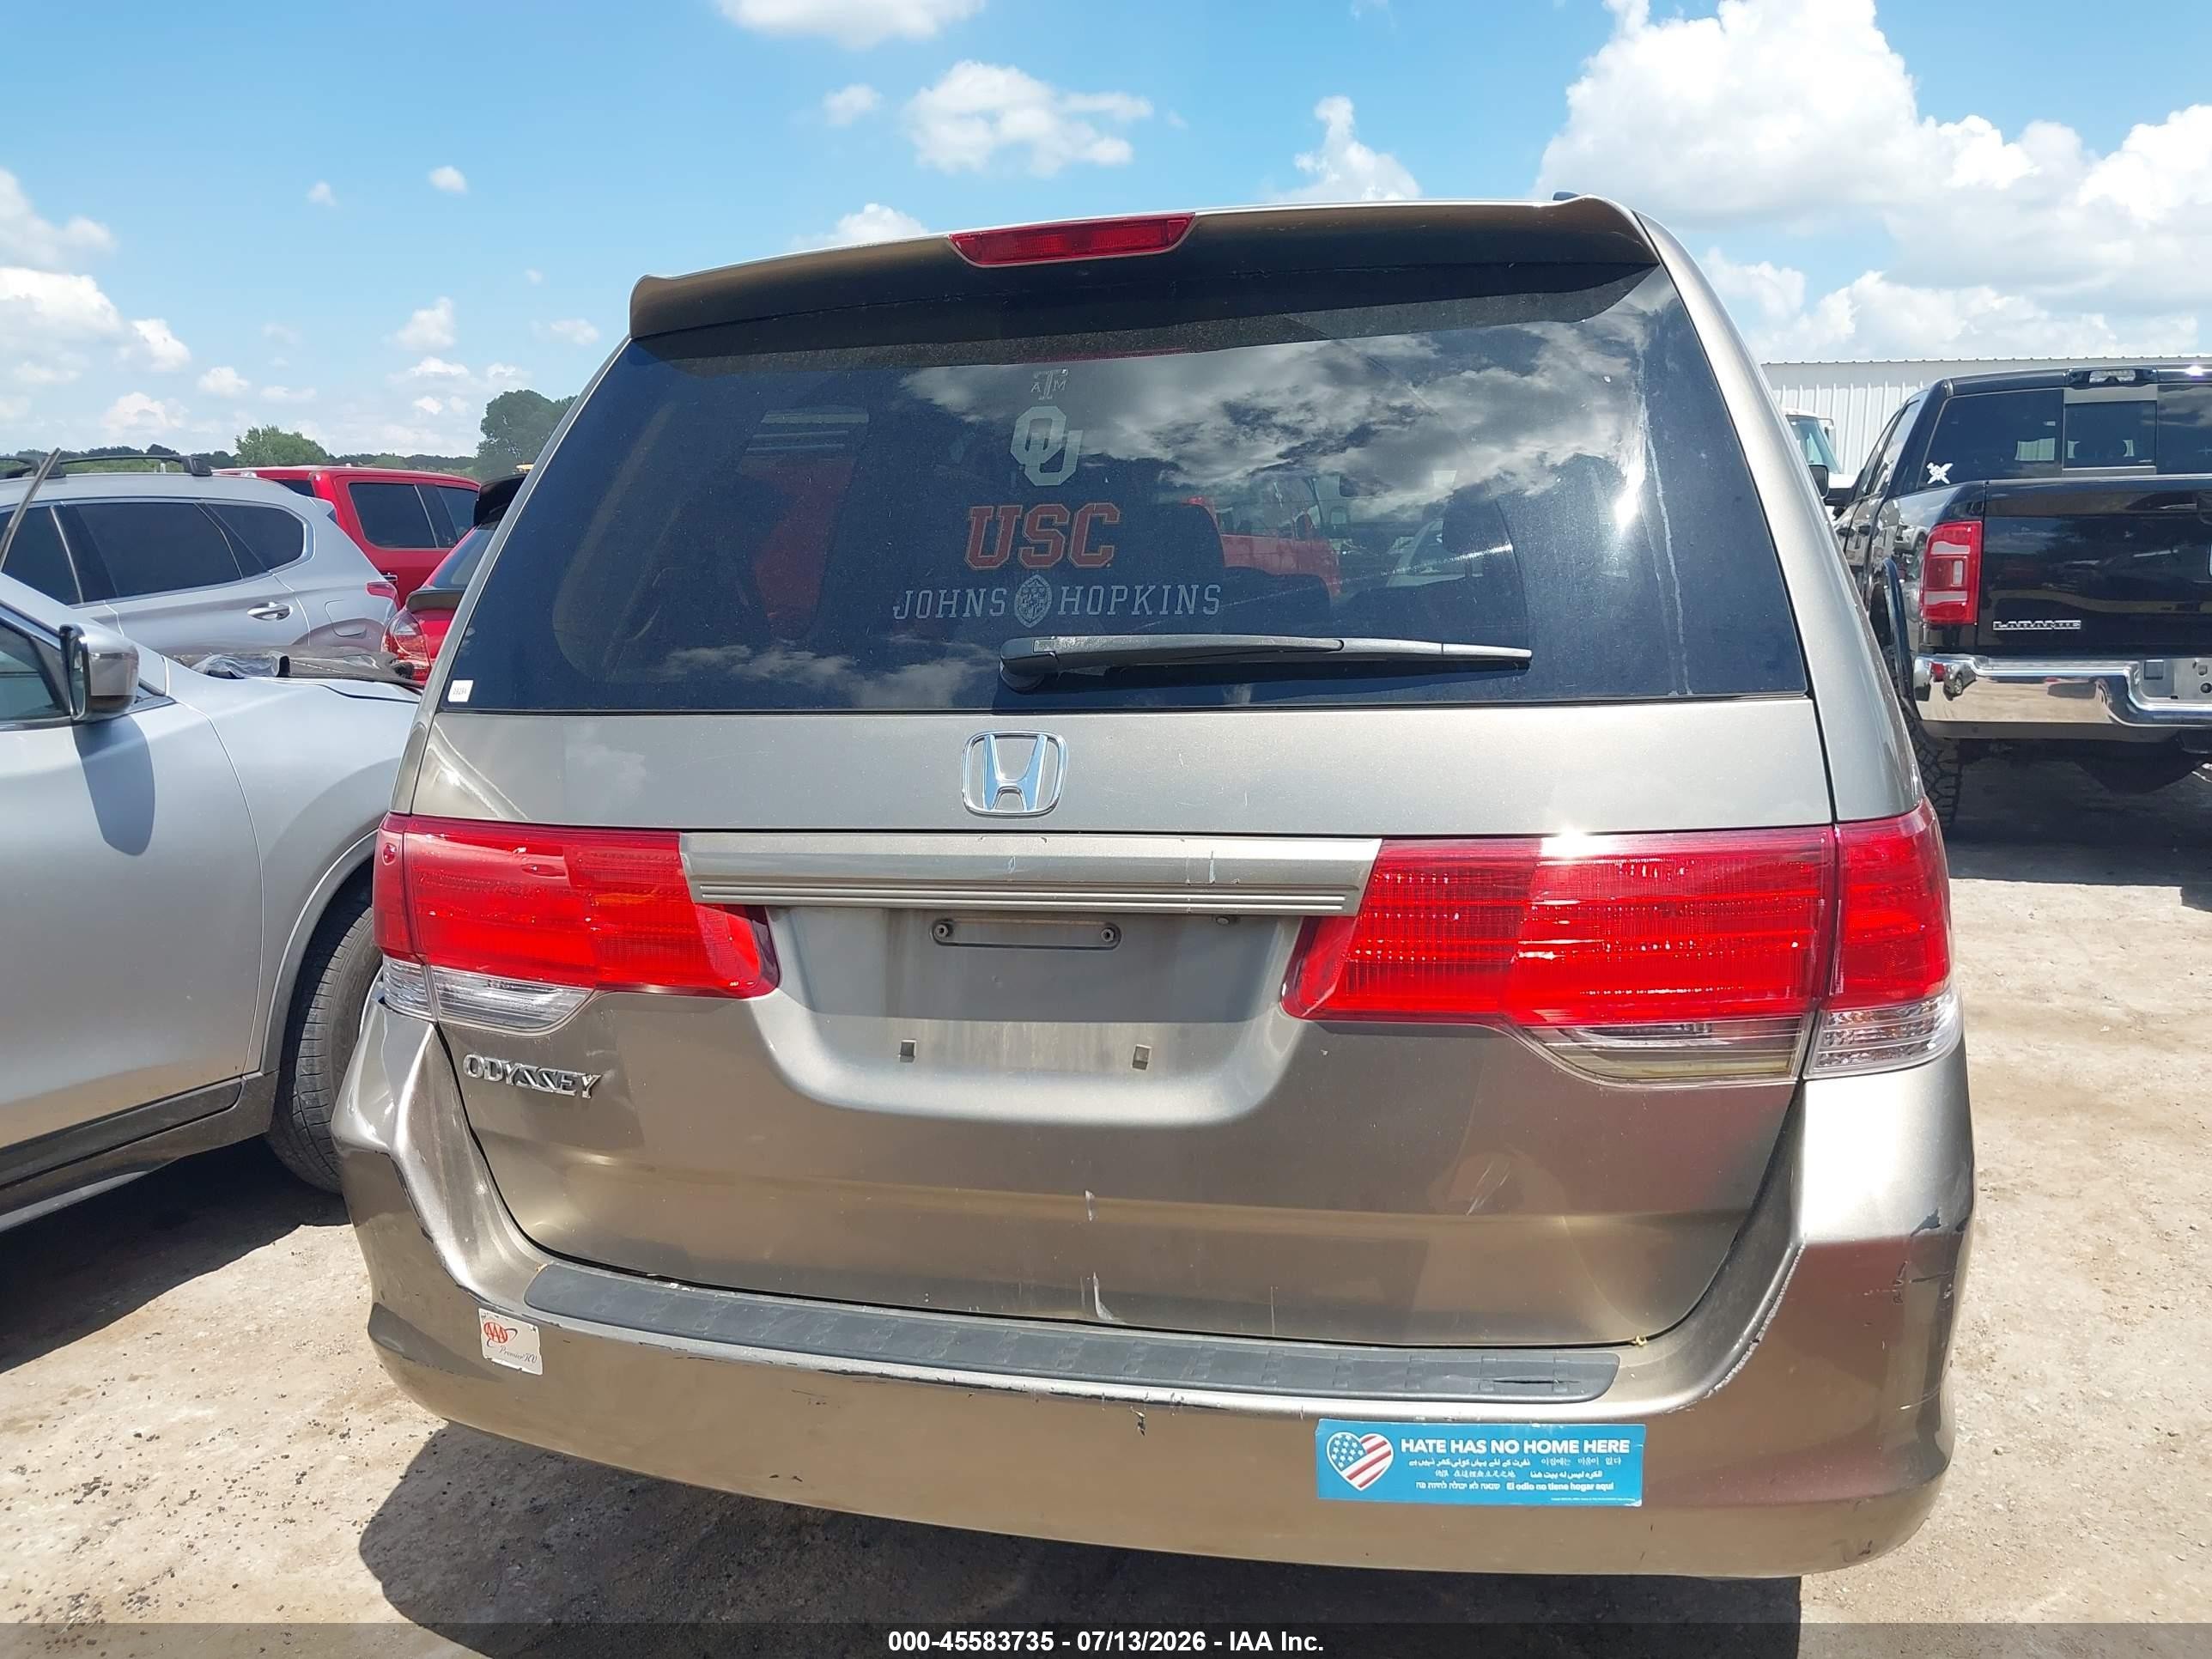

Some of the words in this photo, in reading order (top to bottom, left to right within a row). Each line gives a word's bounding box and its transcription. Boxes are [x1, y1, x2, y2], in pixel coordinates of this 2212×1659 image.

[1011, 405, 1083, 486] OU
[964, 502, 1121, 571] USC
[892, 587, 1006, 620] JOHNS
[1057, 584, 1222, 617] HOPKINS
[462, 1054, 601, 1099] ODYSSEY
[483, 1322, 508, 1344] AAA
[1401, 1438, 1447, 1454] HATE
[1449, 1439, 1487, 1454] HAS
[1491, 1440, 1520, 1454] NO
[1523, 1440, 1580, 1455] HOME
[1583, 1439, 1631, 1455] HERE
[1516, 1482, 1534, 1492] odio
[1547, 1482, 1569, 1492] tiene
[1570, 1481, 1595, 1492] hogar
